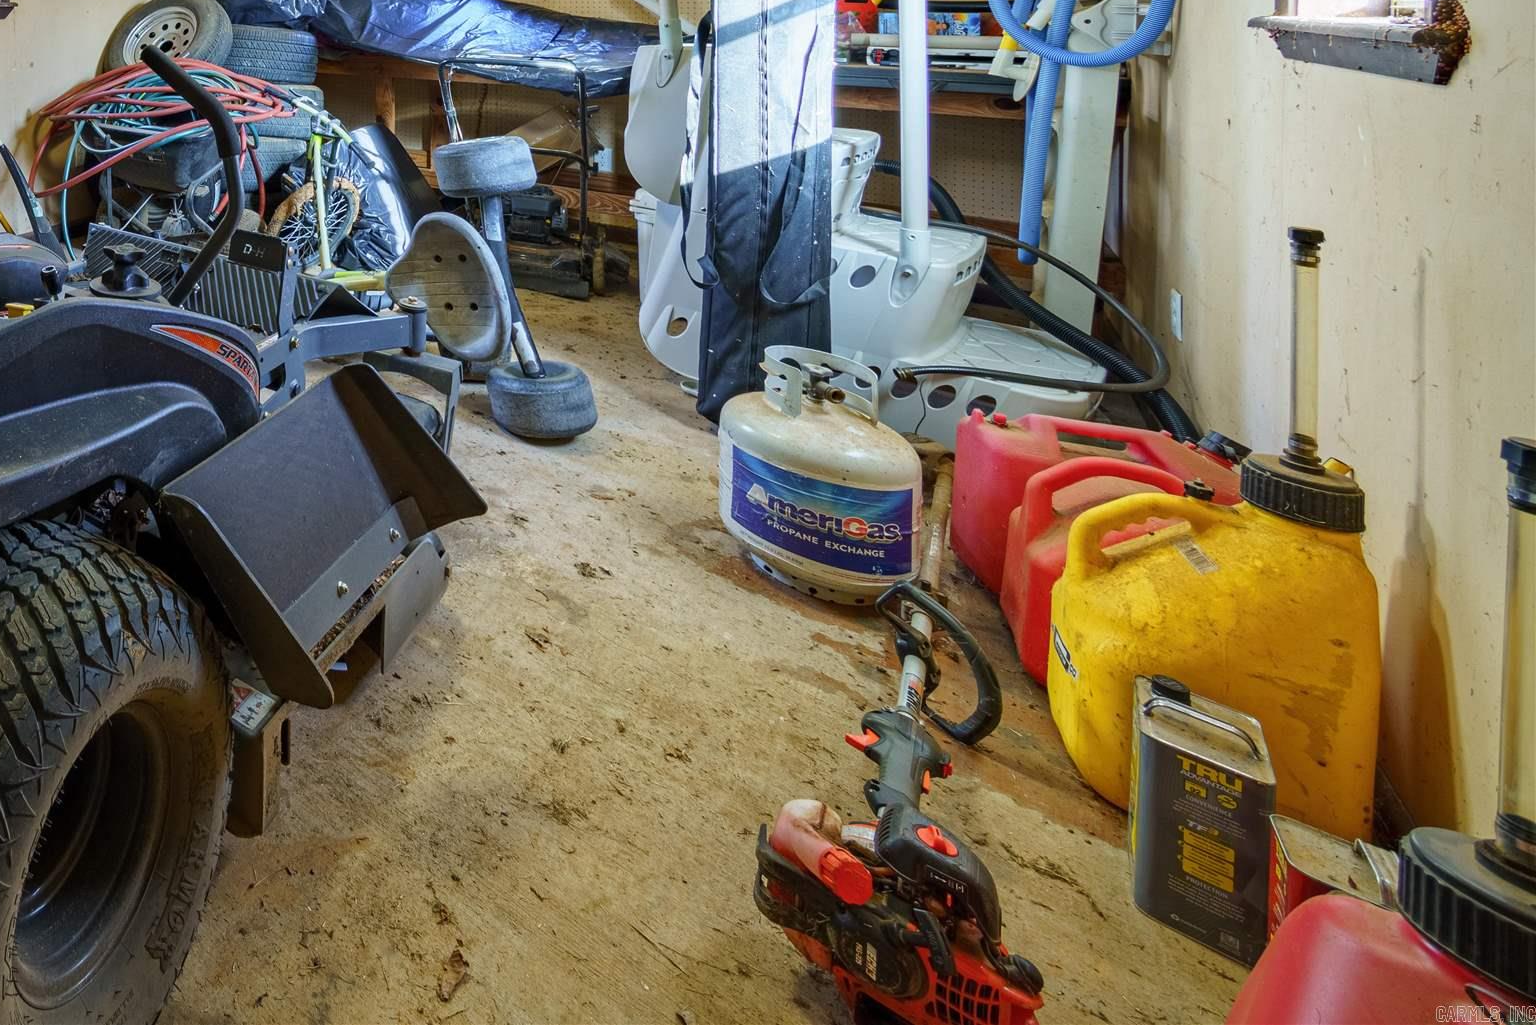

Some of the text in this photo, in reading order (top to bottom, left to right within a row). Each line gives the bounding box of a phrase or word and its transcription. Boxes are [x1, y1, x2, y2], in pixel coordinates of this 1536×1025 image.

[216, 343, 259, 383] SPARTA
[767, 519, 819, 546] PROPANE
[824, 540, 885, 558] EXCHANGE
[1176, 754, 1243, 793] TRU
